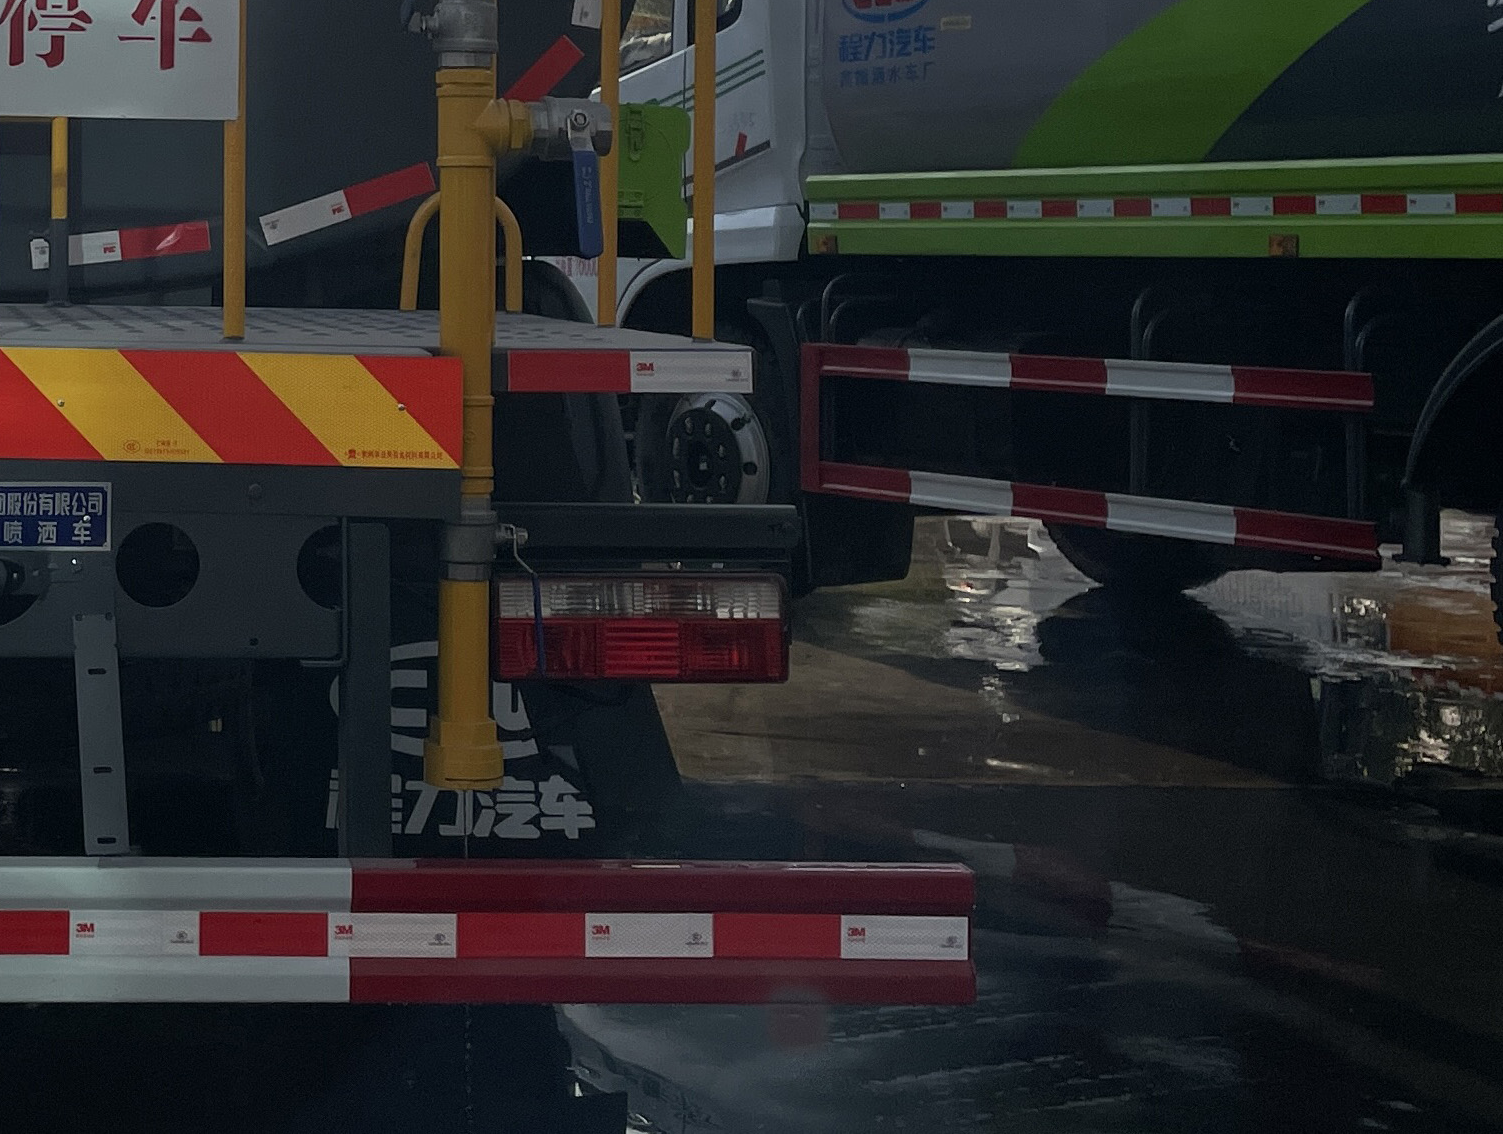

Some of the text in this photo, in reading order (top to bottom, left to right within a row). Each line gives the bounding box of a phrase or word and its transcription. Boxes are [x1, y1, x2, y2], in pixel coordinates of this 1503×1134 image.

[838, 26, 935, 63] 程力汽车
[636, 362, 654, 372] 3M
[76, 923, 94, 933] 3M
[335, 925, 353, 934] 3M
[592, 926, 610, 936] 3M
[847, 927, 866, 937] 3M
